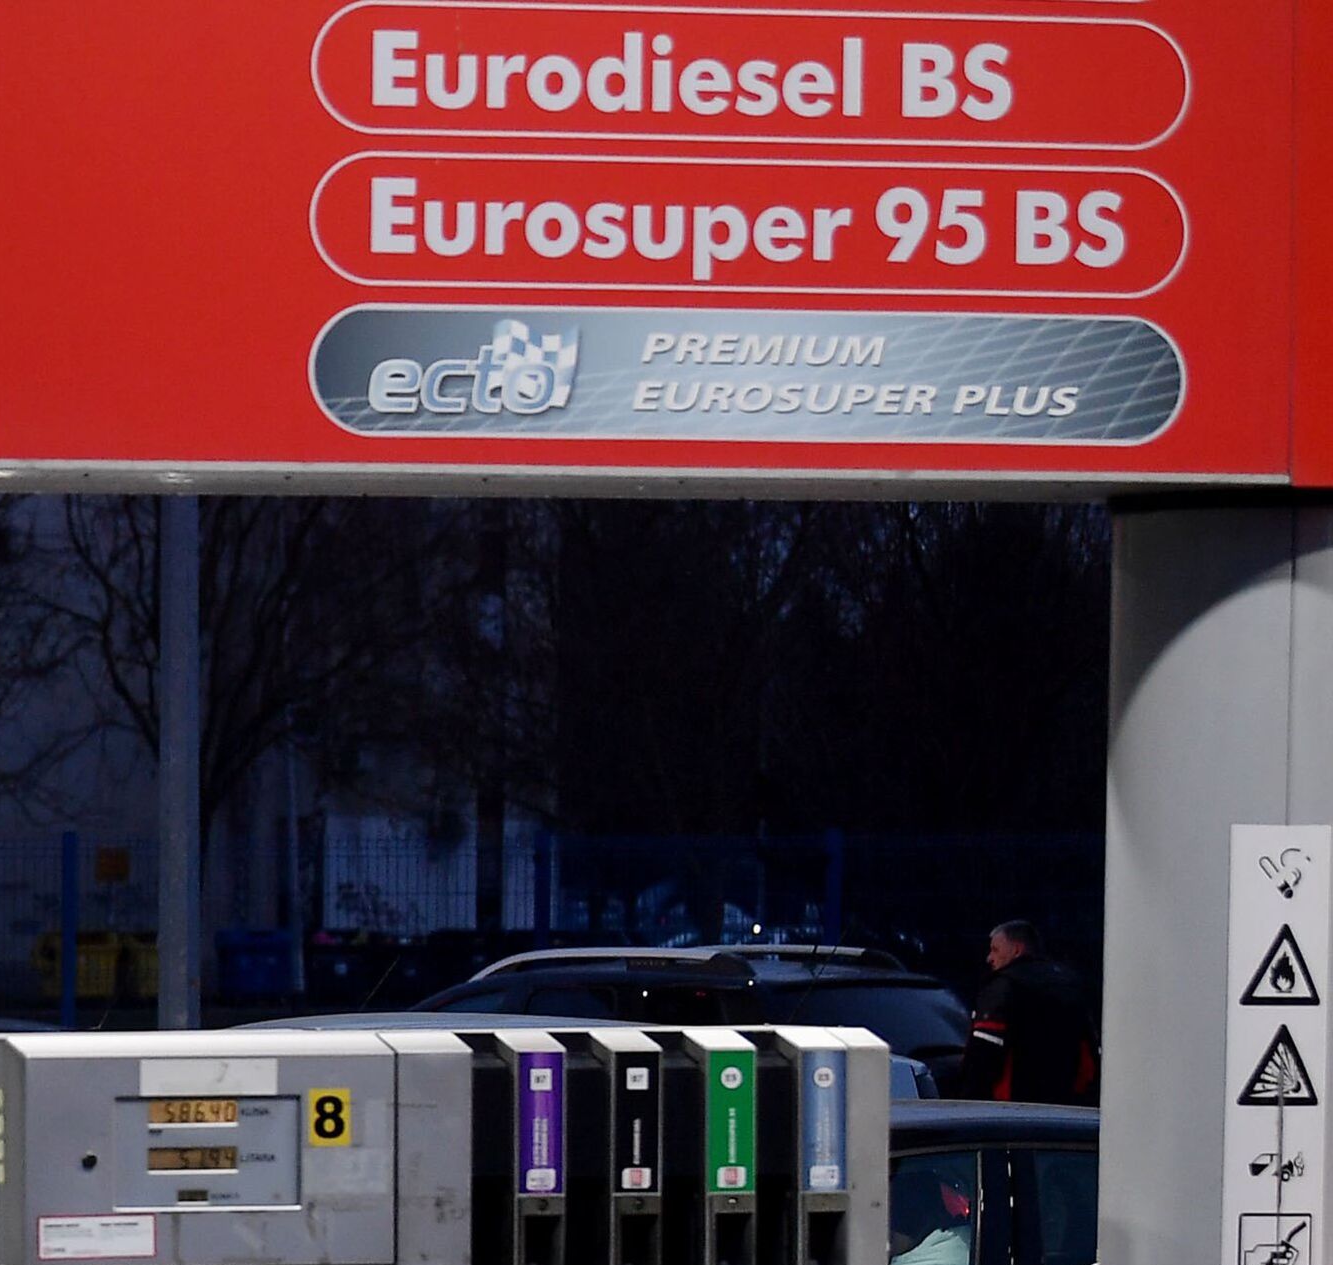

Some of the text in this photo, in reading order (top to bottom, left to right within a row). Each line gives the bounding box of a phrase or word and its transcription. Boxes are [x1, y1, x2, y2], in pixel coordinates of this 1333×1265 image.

[371, 30, 1013, 120] Eurodiesel BS
[370, 177, 1125, 281] Eurosuper 95 BS
[641, 333, 885, 367] PREMIUM
[368, 345, 557, 415] ecto
[633, 381, 1079, 417] EUROSUPER PLUS
[314, 1095, 346, 1139] 8
